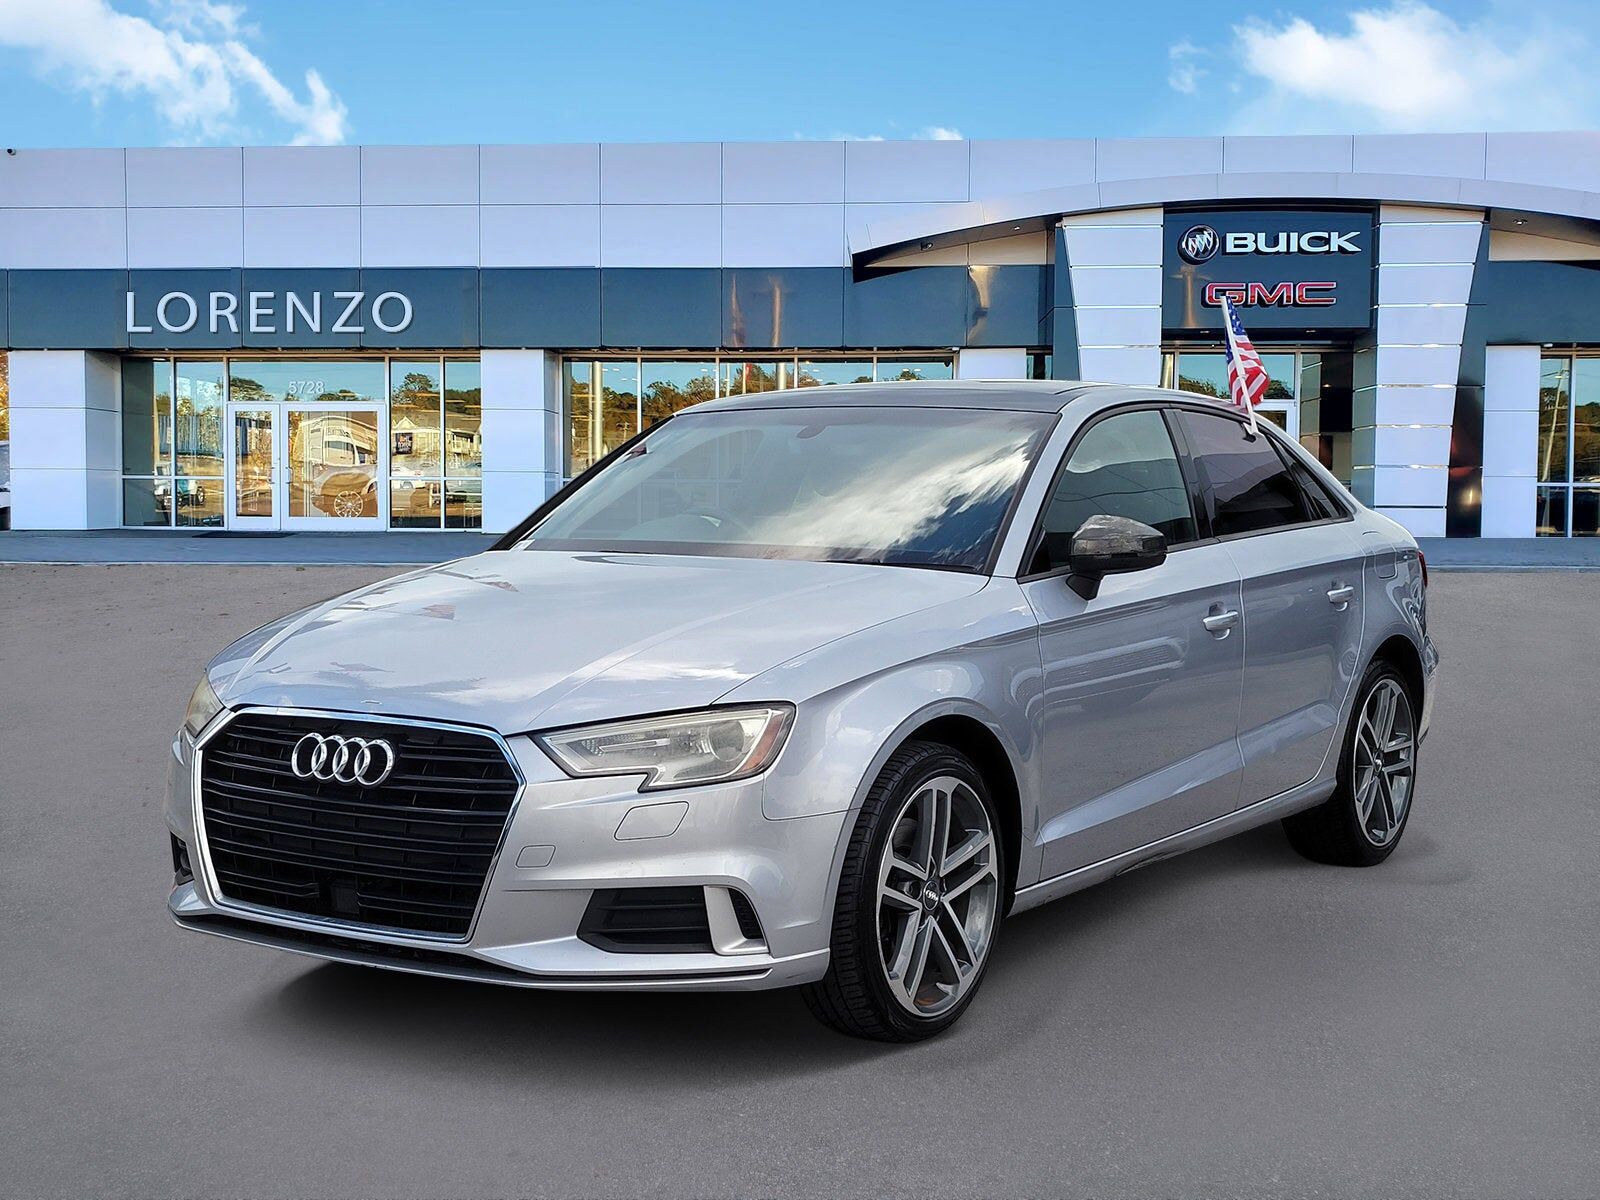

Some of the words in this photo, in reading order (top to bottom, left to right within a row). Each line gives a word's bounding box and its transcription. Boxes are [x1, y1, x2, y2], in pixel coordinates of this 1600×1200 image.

[1225, 231, 1361, 253] BUICK
[1205, 282, 1337, 305] GMC
[126, 291, 413, 333] LORENZO
[288, 380, 326, 395] 5728
